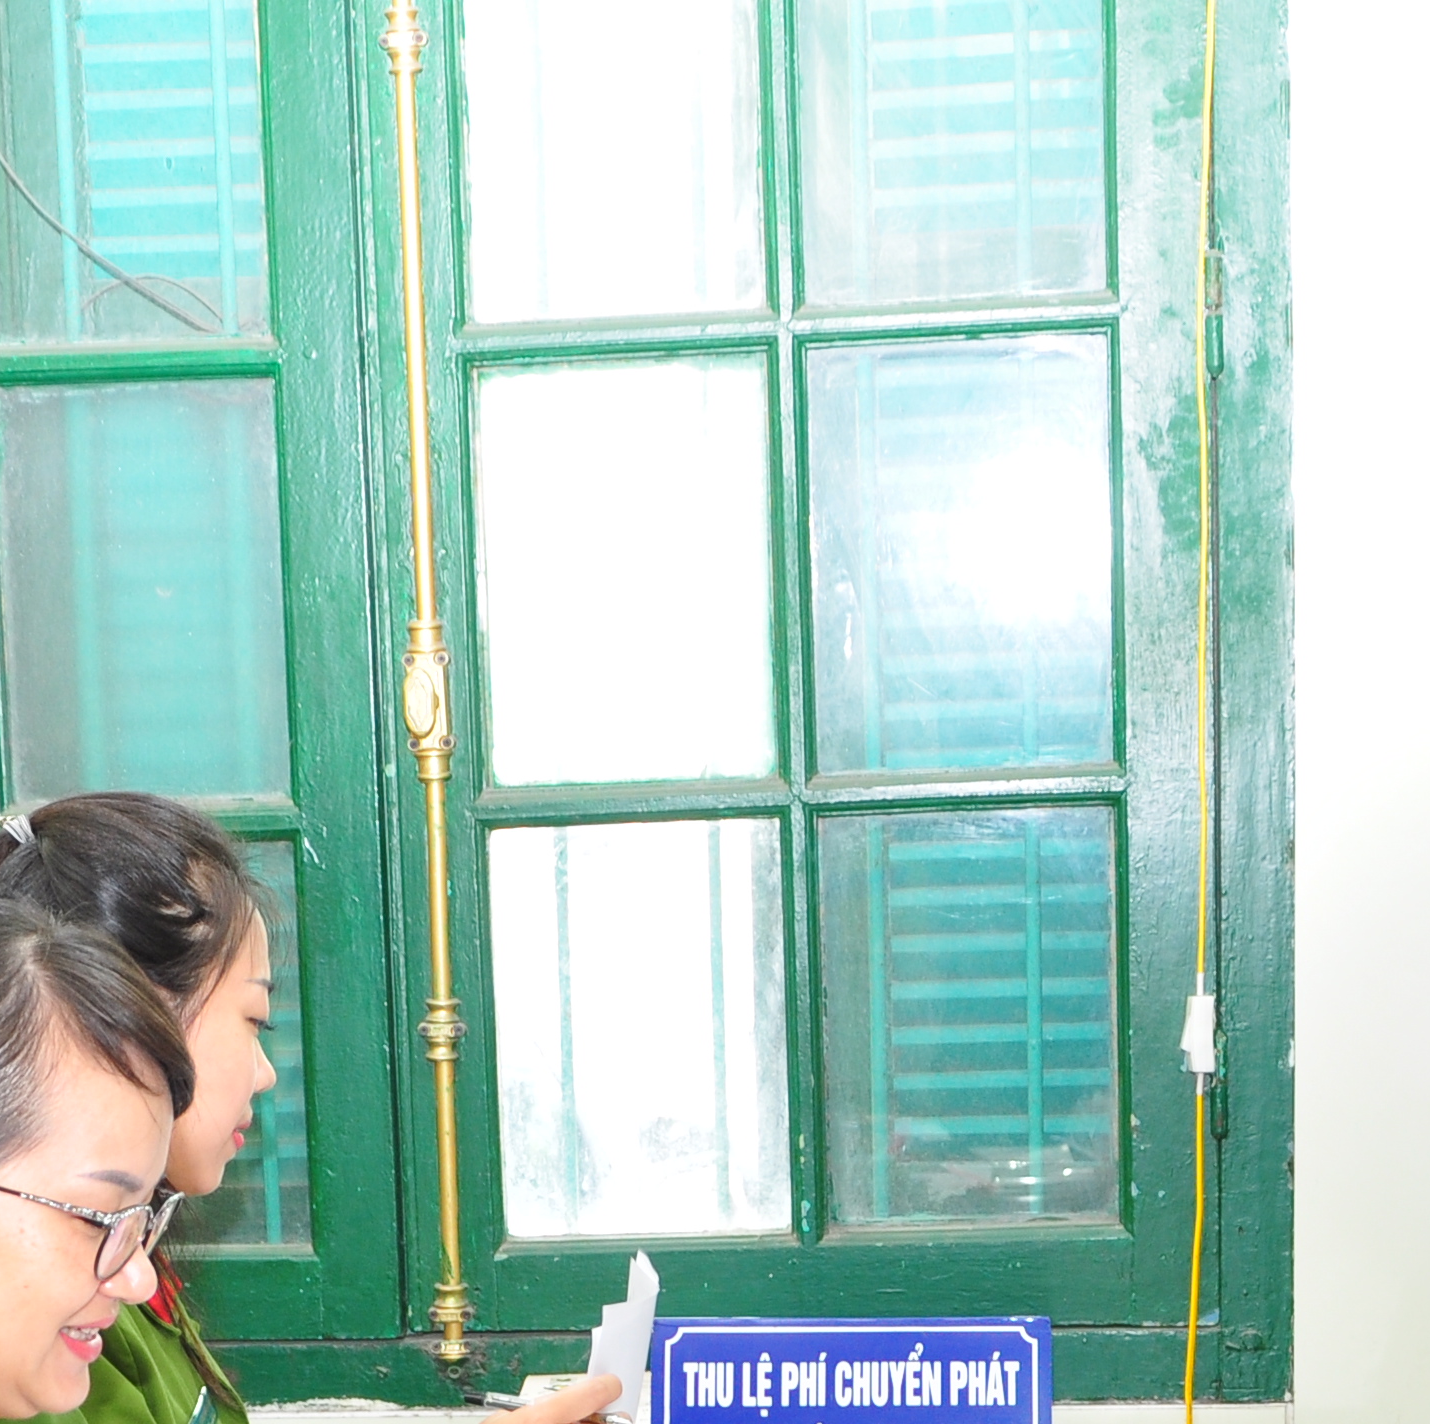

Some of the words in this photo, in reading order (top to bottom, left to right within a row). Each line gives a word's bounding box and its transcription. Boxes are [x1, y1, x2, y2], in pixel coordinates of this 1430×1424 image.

[683, 1362, 734, 1407] THU
[742, 1352, 772, 1417] LỆ
[781, 1352, 827, 1407] PHÍ
[835, 1343, 941, 1407] CHUYỂN
[950, 1351, 1020, 1406] PHÁT
